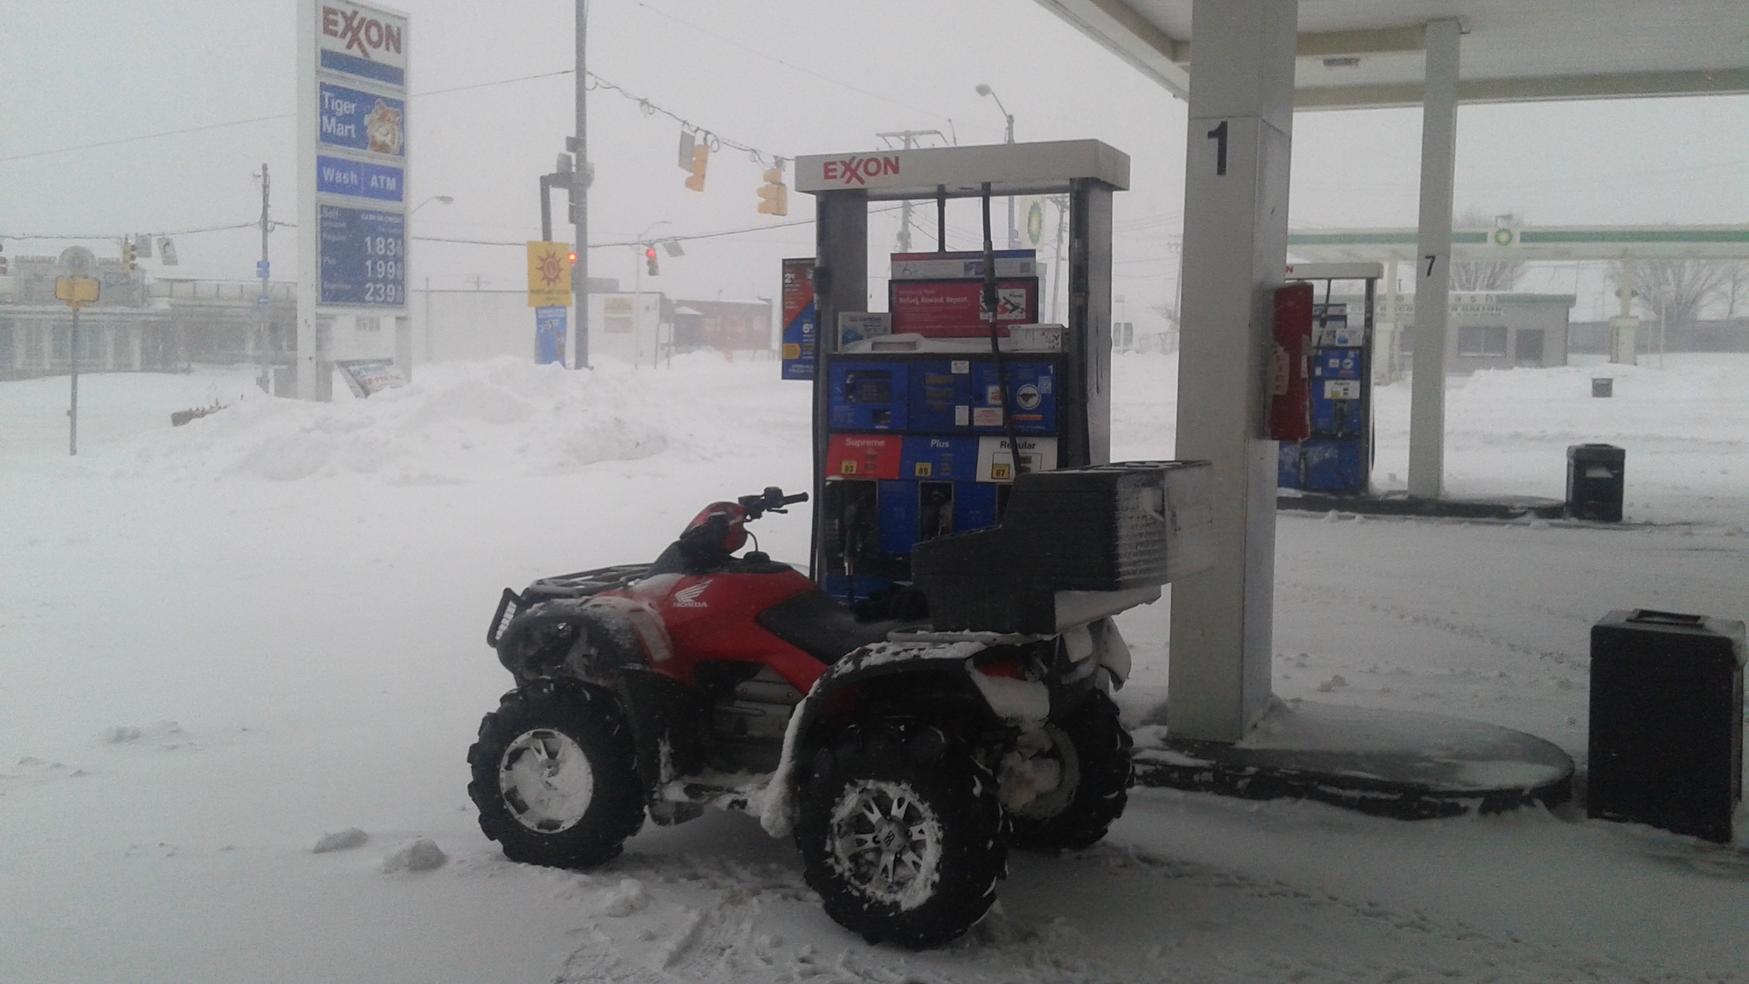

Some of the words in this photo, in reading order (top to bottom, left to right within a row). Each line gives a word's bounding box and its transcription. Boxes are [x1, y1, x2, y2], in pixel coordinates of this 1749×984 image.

[322, 5, 402, 58] EXXON
[322, 91, 357, 116] Tiger
[322, 115, 357, 138] Mart
[1207, 120, 1228, 176] 1
[322, 167, 358, 185] Wash
[823, 155, 900, 185] EXXON
[370, 174, 397, 191] ATM
[1424, 255, 1437, 278] 7
[845, 438, 886, 448] Supreme
[930, 439, 950, 448] Plus
[1000, 440, 1037, 449] Reular
